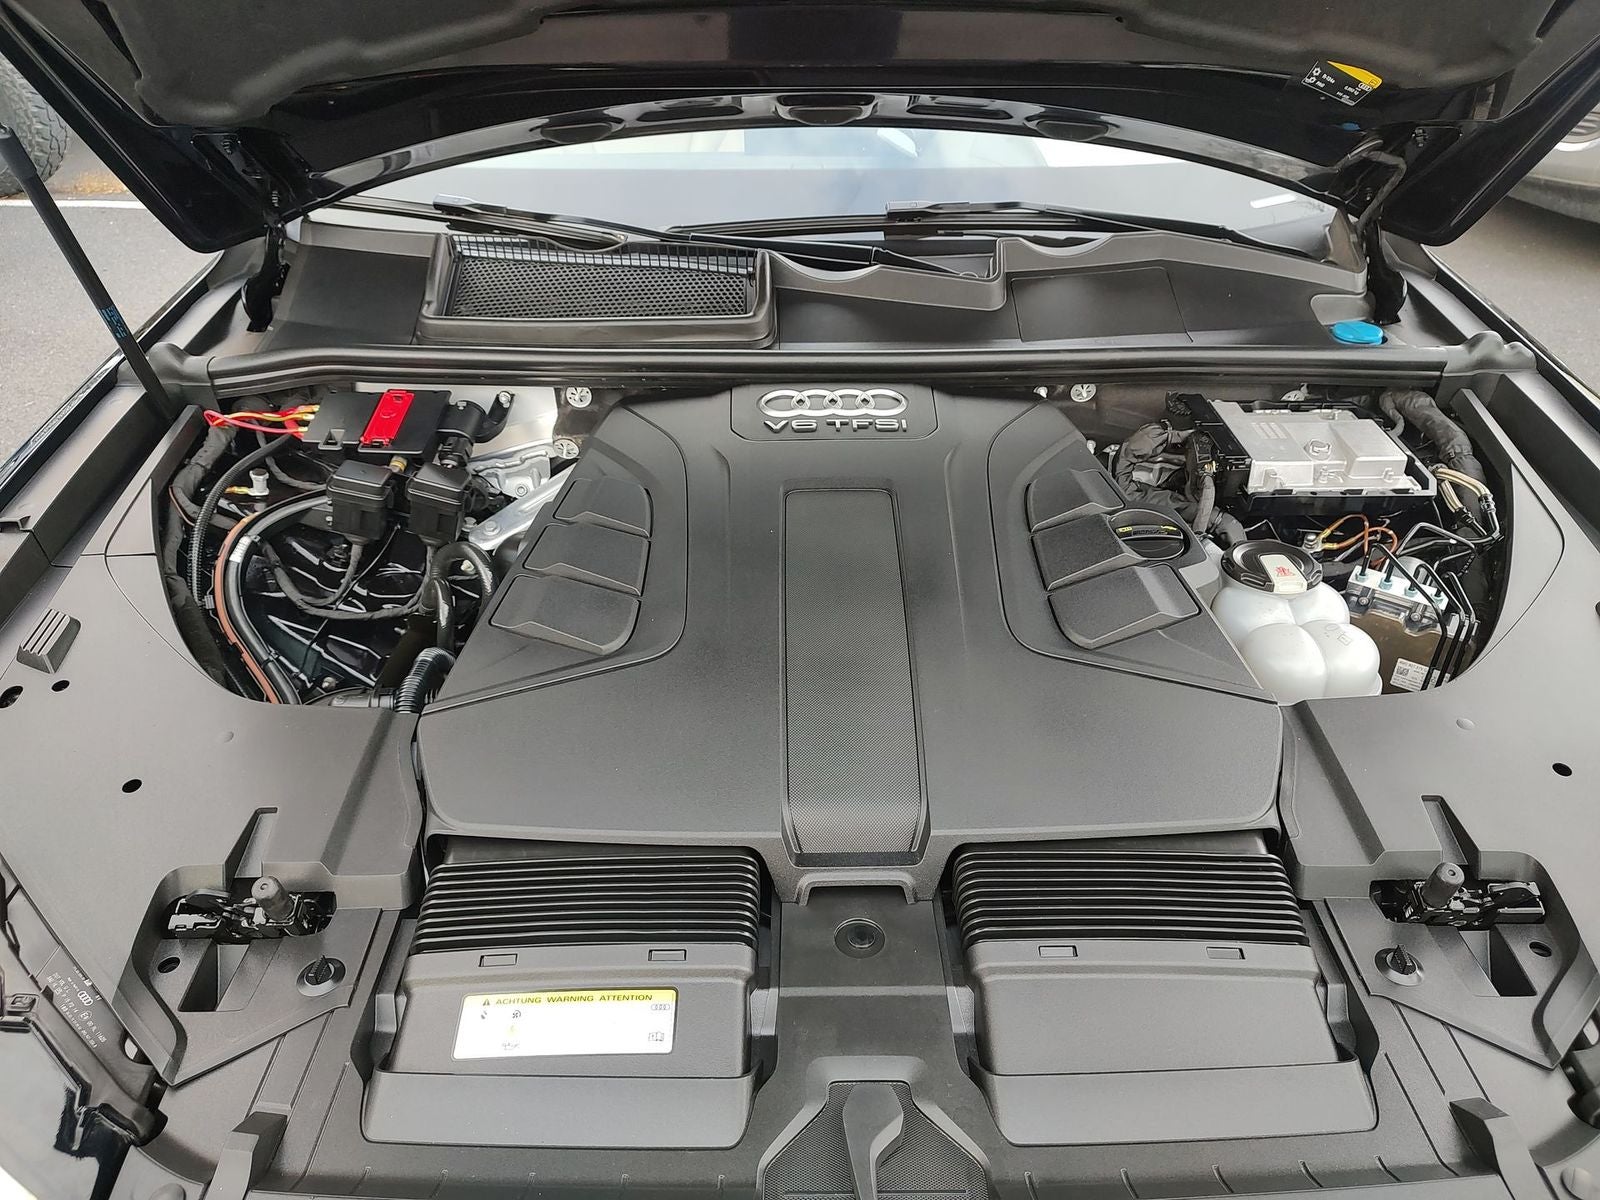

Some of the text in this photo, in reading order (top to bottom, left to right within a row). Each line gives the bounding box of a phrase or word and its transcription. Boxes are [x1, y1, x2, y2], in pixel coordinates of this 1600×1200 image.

[763, 418, 908, 433] V6 TFSI
[495, 993, 653, 1005] ACHTUNG WARNING ATTENTION
